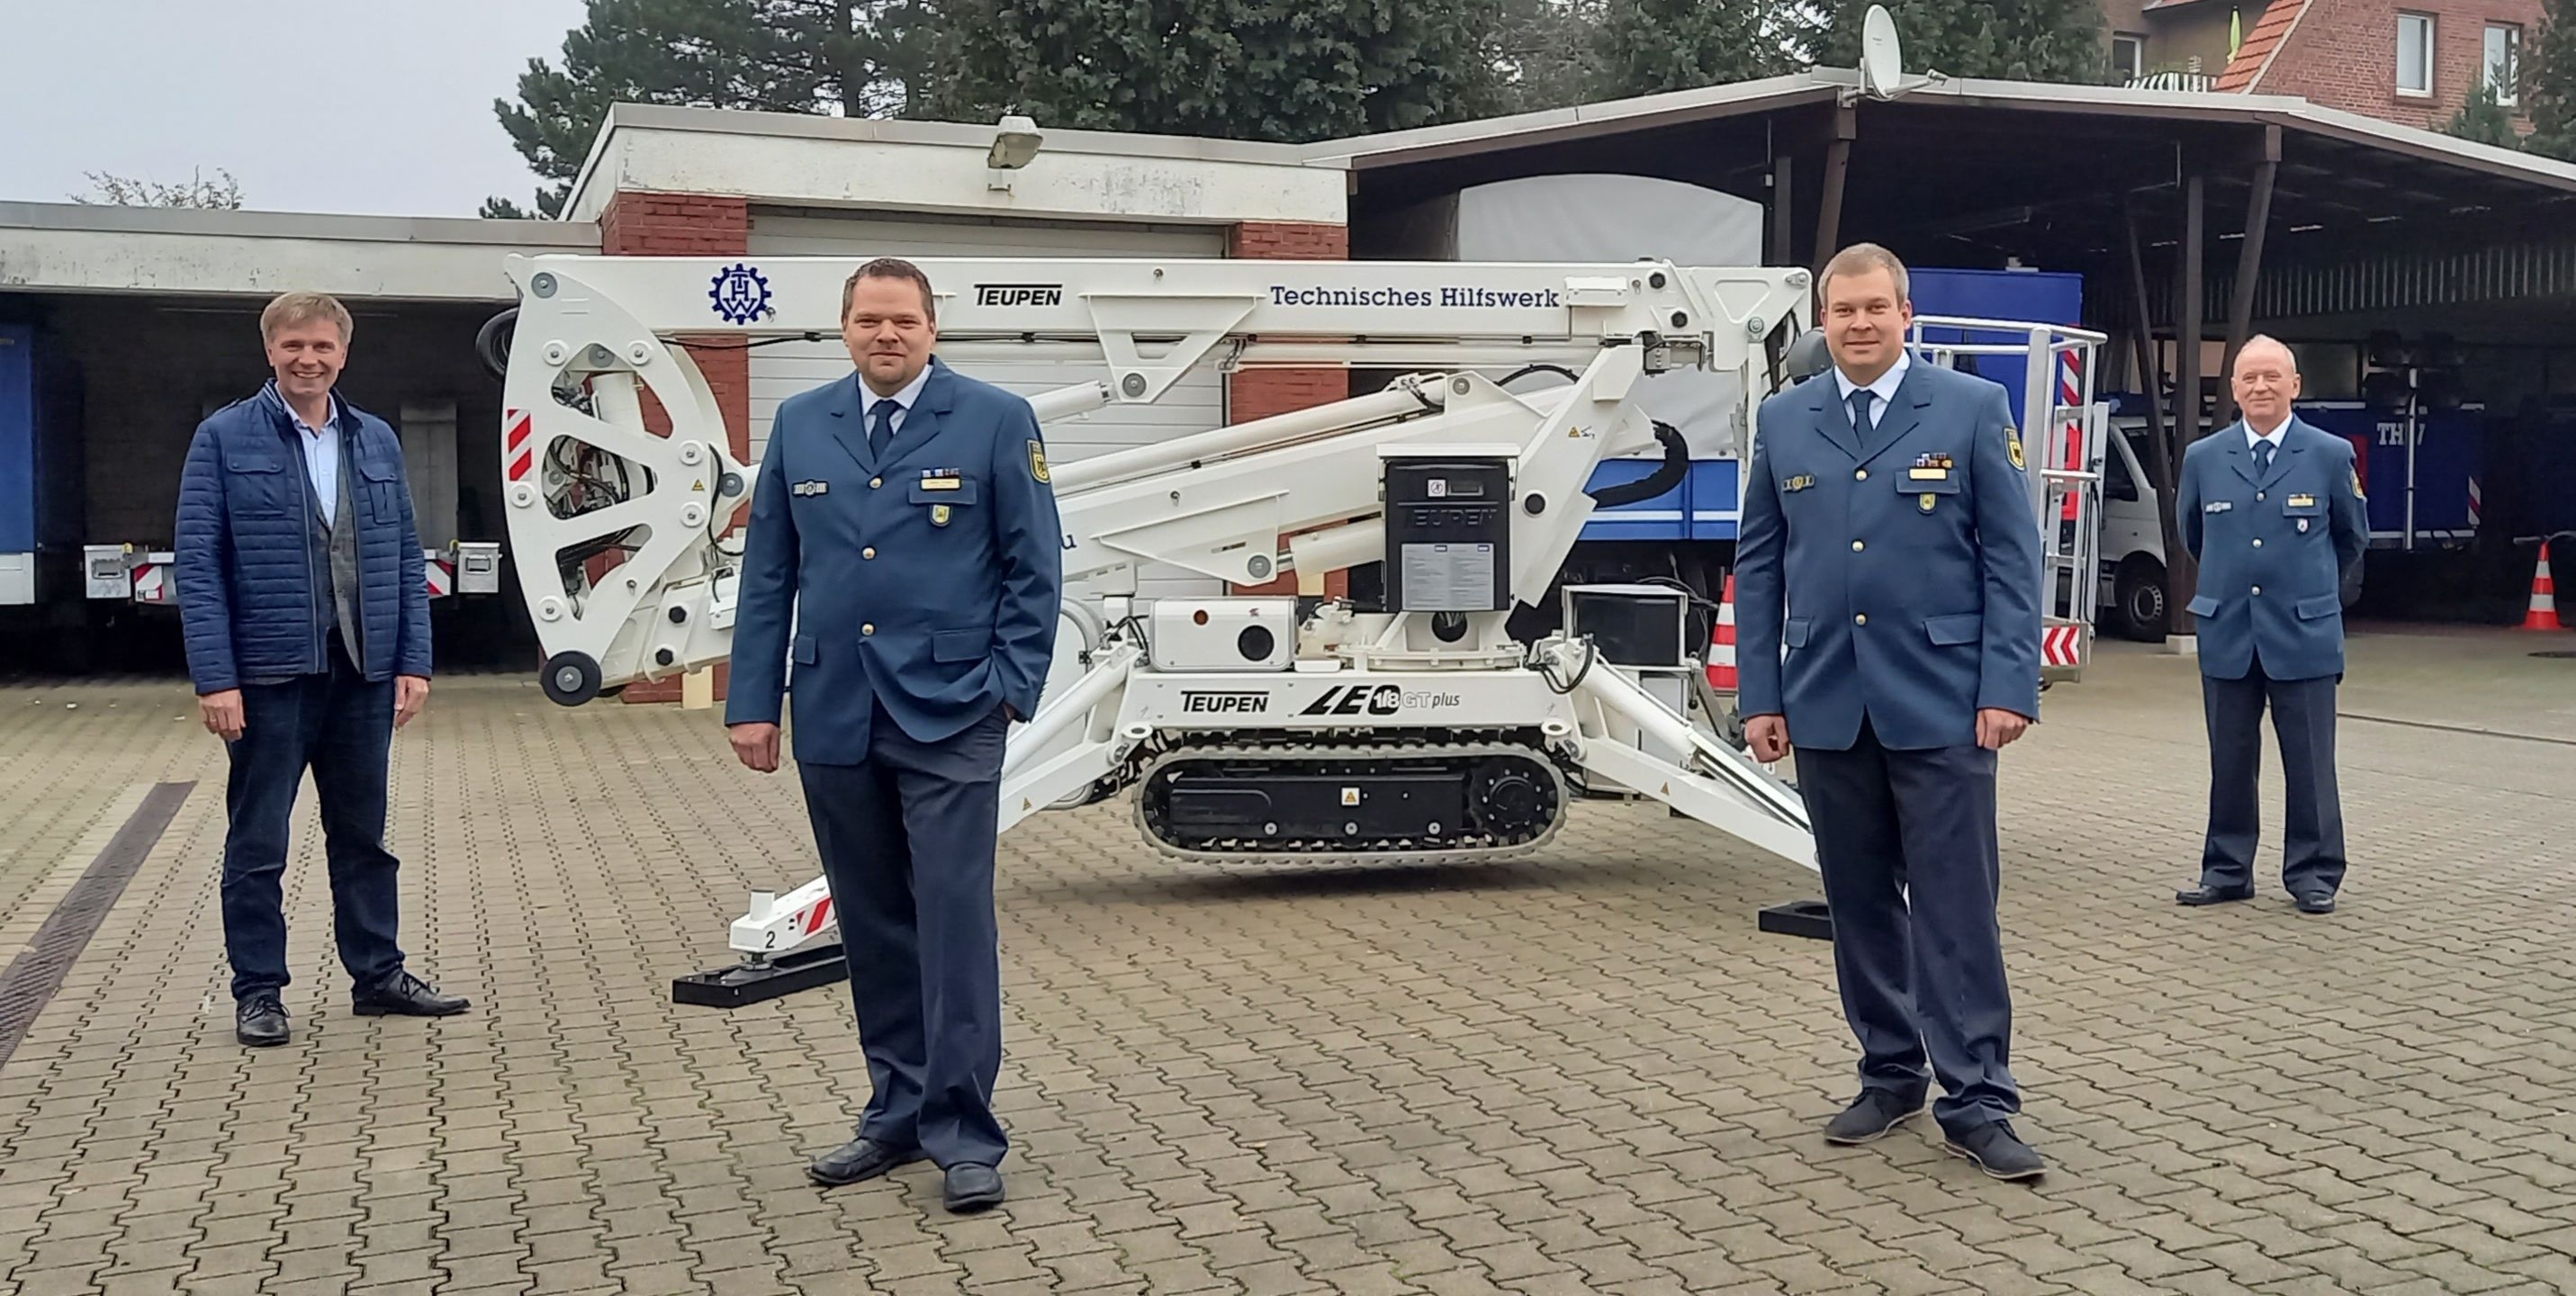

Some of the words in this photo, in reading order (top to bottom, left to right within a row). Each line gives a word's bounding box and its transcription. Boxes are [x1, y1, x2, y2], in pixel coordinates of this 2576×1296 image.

[973, 284, 1062, 306] TEUPEN
[1270, 286, 1431, 306] Technisches
[1440, 287, 1559, 308] Hilfswerk
[1181, 690, 1270, 713] TEUPEN
[1432, 693, 1461, 709] plus
[765, 931, 776, 949] 2
